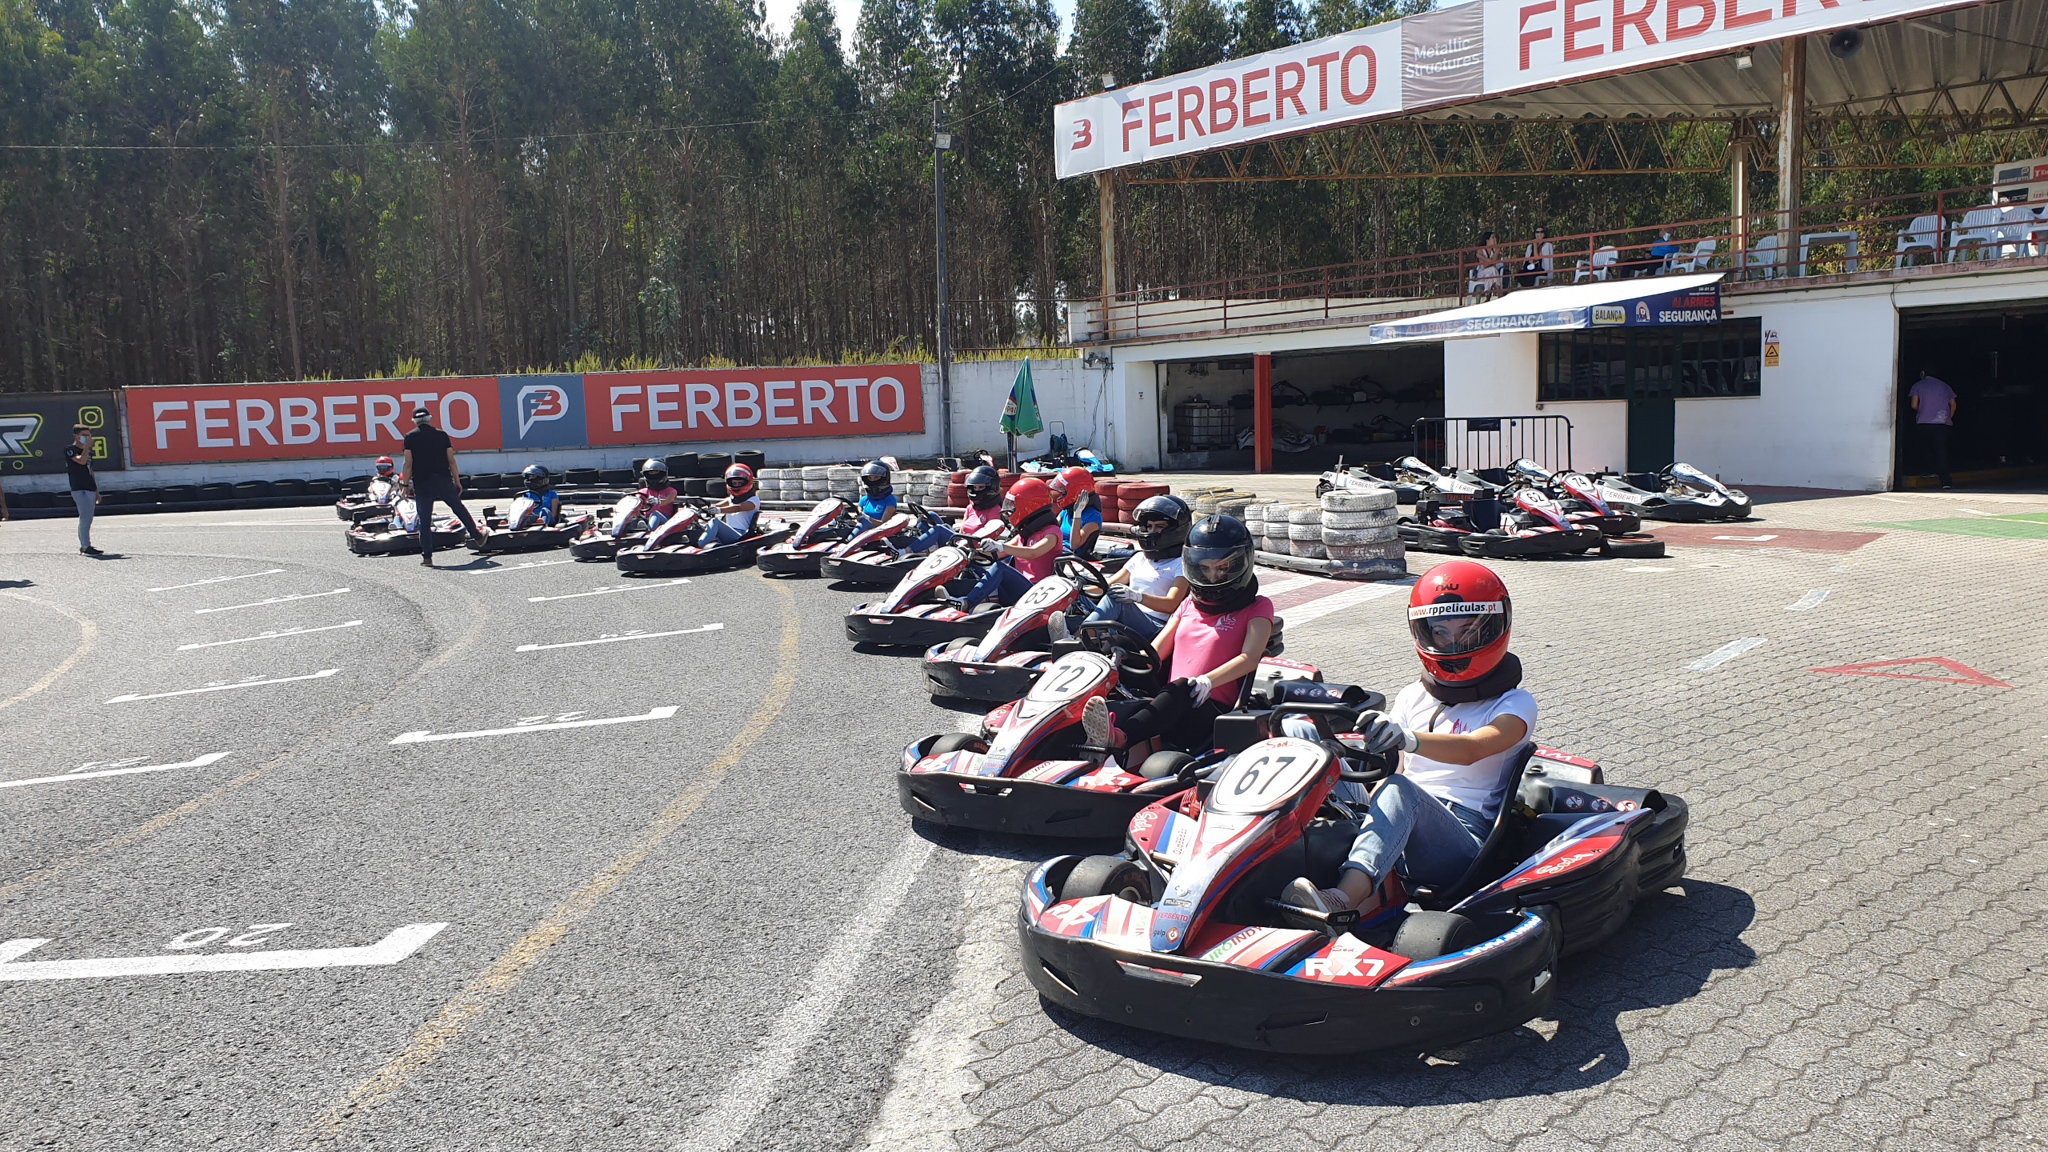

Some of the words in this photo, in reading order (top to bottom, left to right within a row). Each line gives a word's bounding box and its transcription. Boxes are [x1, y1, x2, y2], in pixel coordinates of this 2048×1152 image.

[1414, 37, 1471, 60] Metallic
[1405, 53, 1480, 78] Structures
[1122, 45, 1377, 152] FERBERTO
[1672, 296, 1716, 308] ALARMES
[1406, 320, 1460, 336] ALARMES
[1466, 313, 1545, 331] SEGURANÇA
[1595, 309, 1623, 322] BALANÇA
[1658, 309, 1718, 324] SEGURANÇA
[610, 376, 906, 432] FERBERTO
[153, 390, 480, 450] FERBERTO
[1572, 477, 1587, 487] 74
[1526, 492, 1545, 503] 62
[1025, 586, 1056, 605] 65
[1411, 602, 1497, 617] www.rppeliculas.pt
[1044, 665, 1086, 693] 72
[1234, 756, 1296, 796] 67
[1157, 911, 1189, 922] FERBERTO
[1153, 929, 1166, 938] galp
[1305, 958, 1385, 977] RX7
